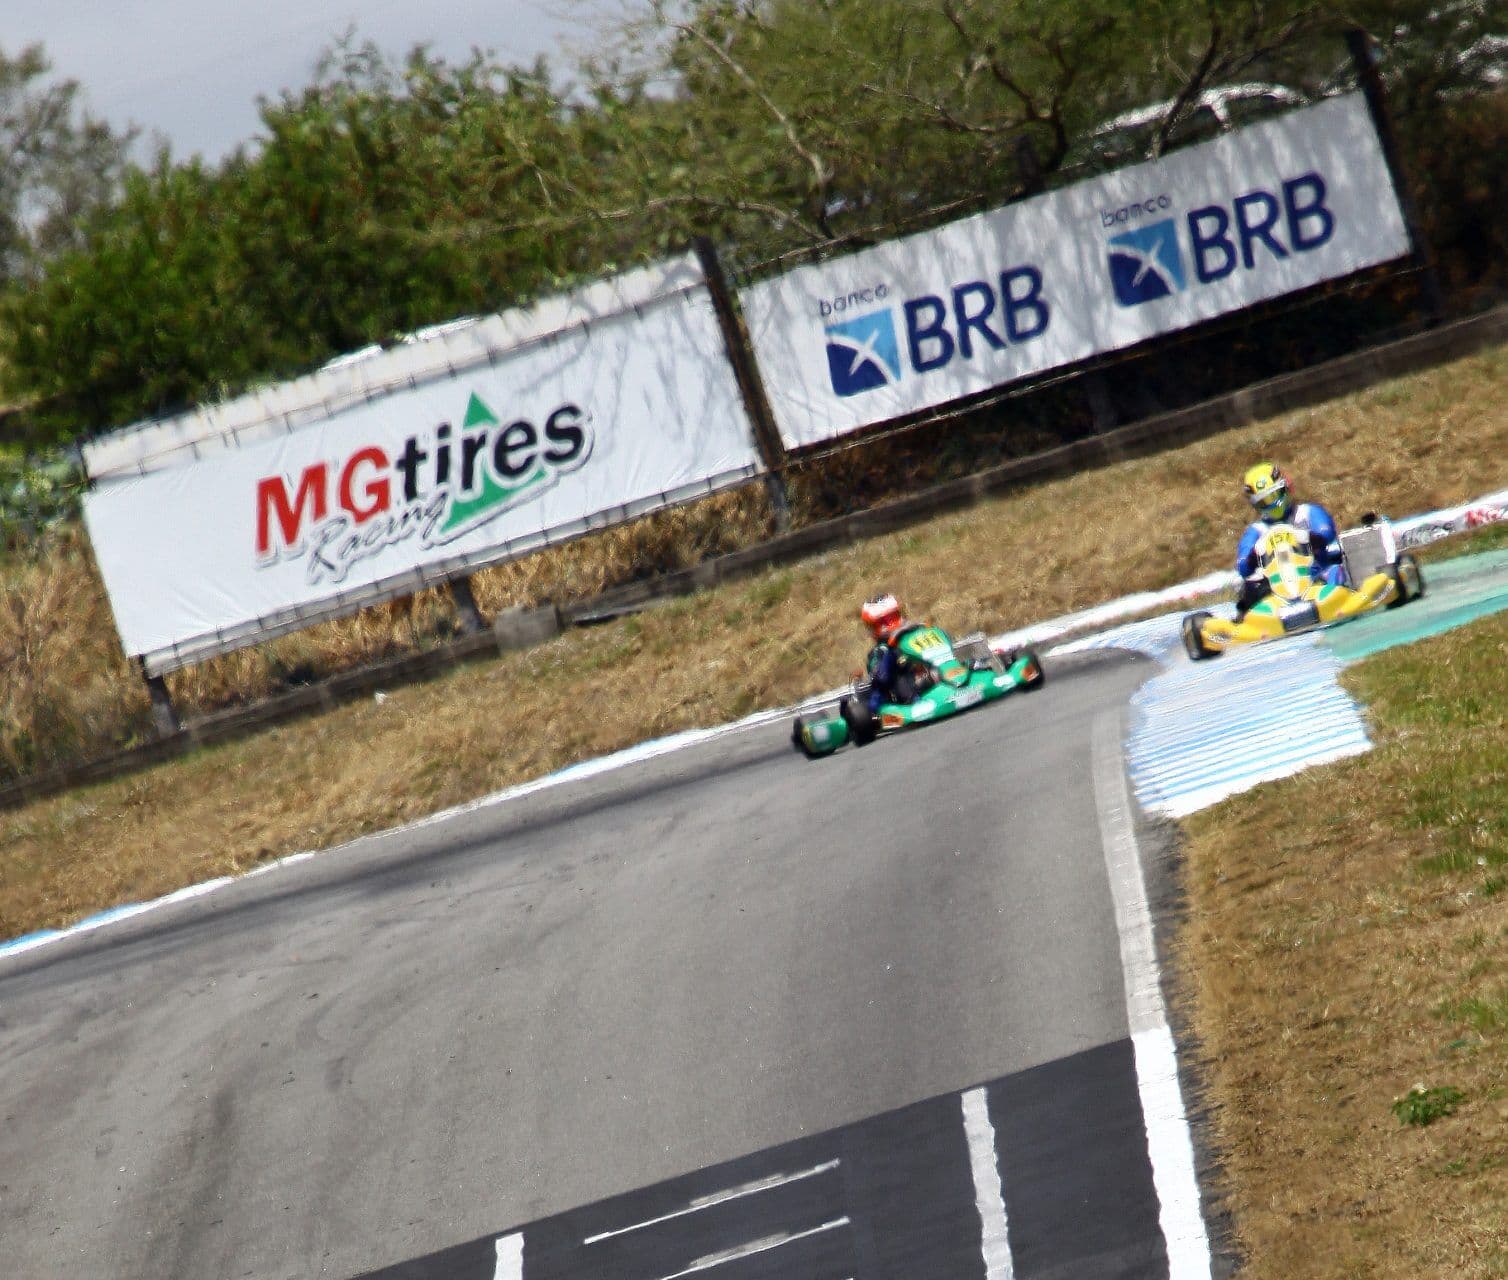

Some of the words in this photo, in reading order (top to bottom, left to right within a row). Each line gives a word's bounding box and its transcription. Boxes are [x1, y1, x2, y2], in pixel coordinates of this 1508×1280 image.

[1101, 195, 1171, 228] banco
[1187, 172, 1335, 283] BRB
[819, 284, 888, 317] banco
[903, 265, 1049, 373] BRB
[308, 492, 449, 576] Racing
